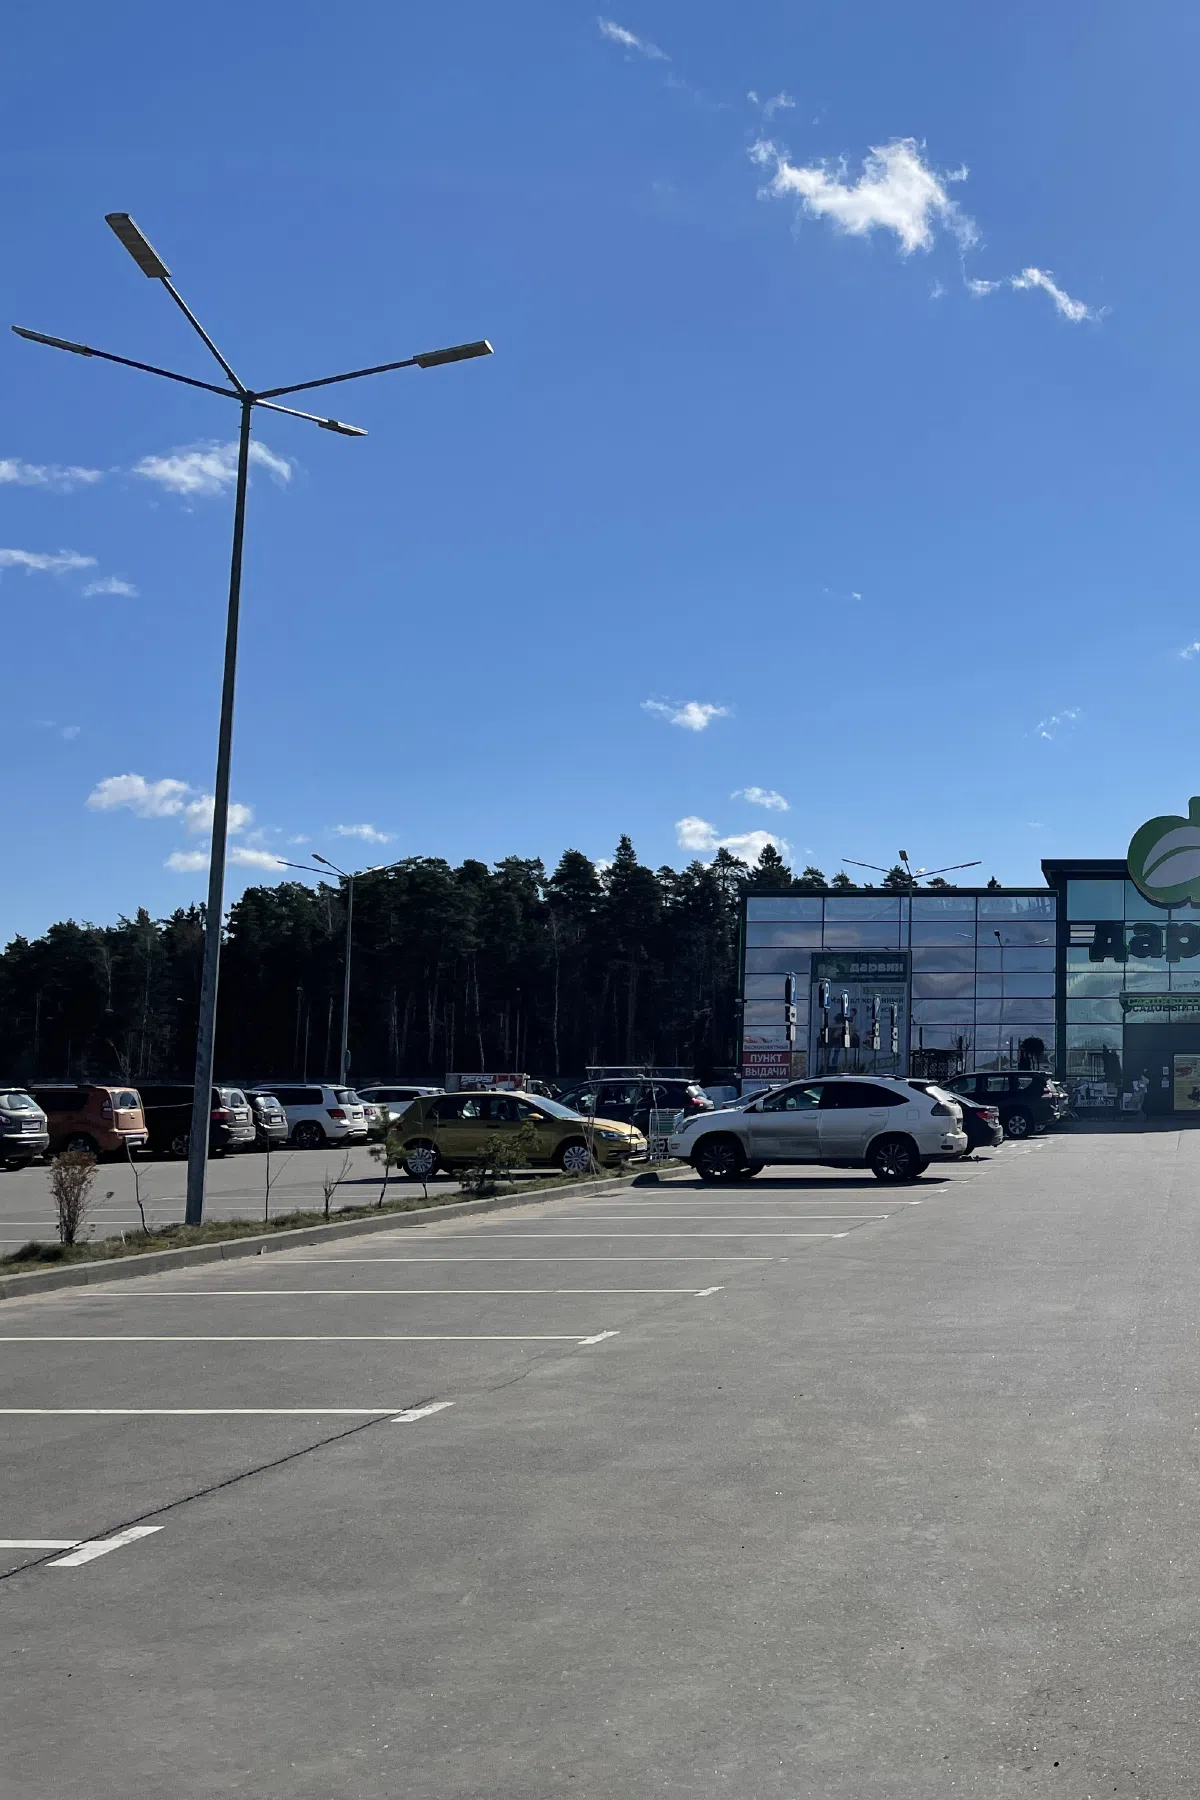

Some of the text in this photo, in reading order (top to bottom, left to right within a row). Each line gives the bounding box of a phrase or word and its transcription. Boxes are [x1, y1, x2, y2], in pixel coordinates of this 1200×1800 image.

[750, 1053, 782, 1063] ПУНКТ
[745, 1067, 787, 1077] ВЫДАЧИ
[460, 1075, 494, 1083] PEPSI
